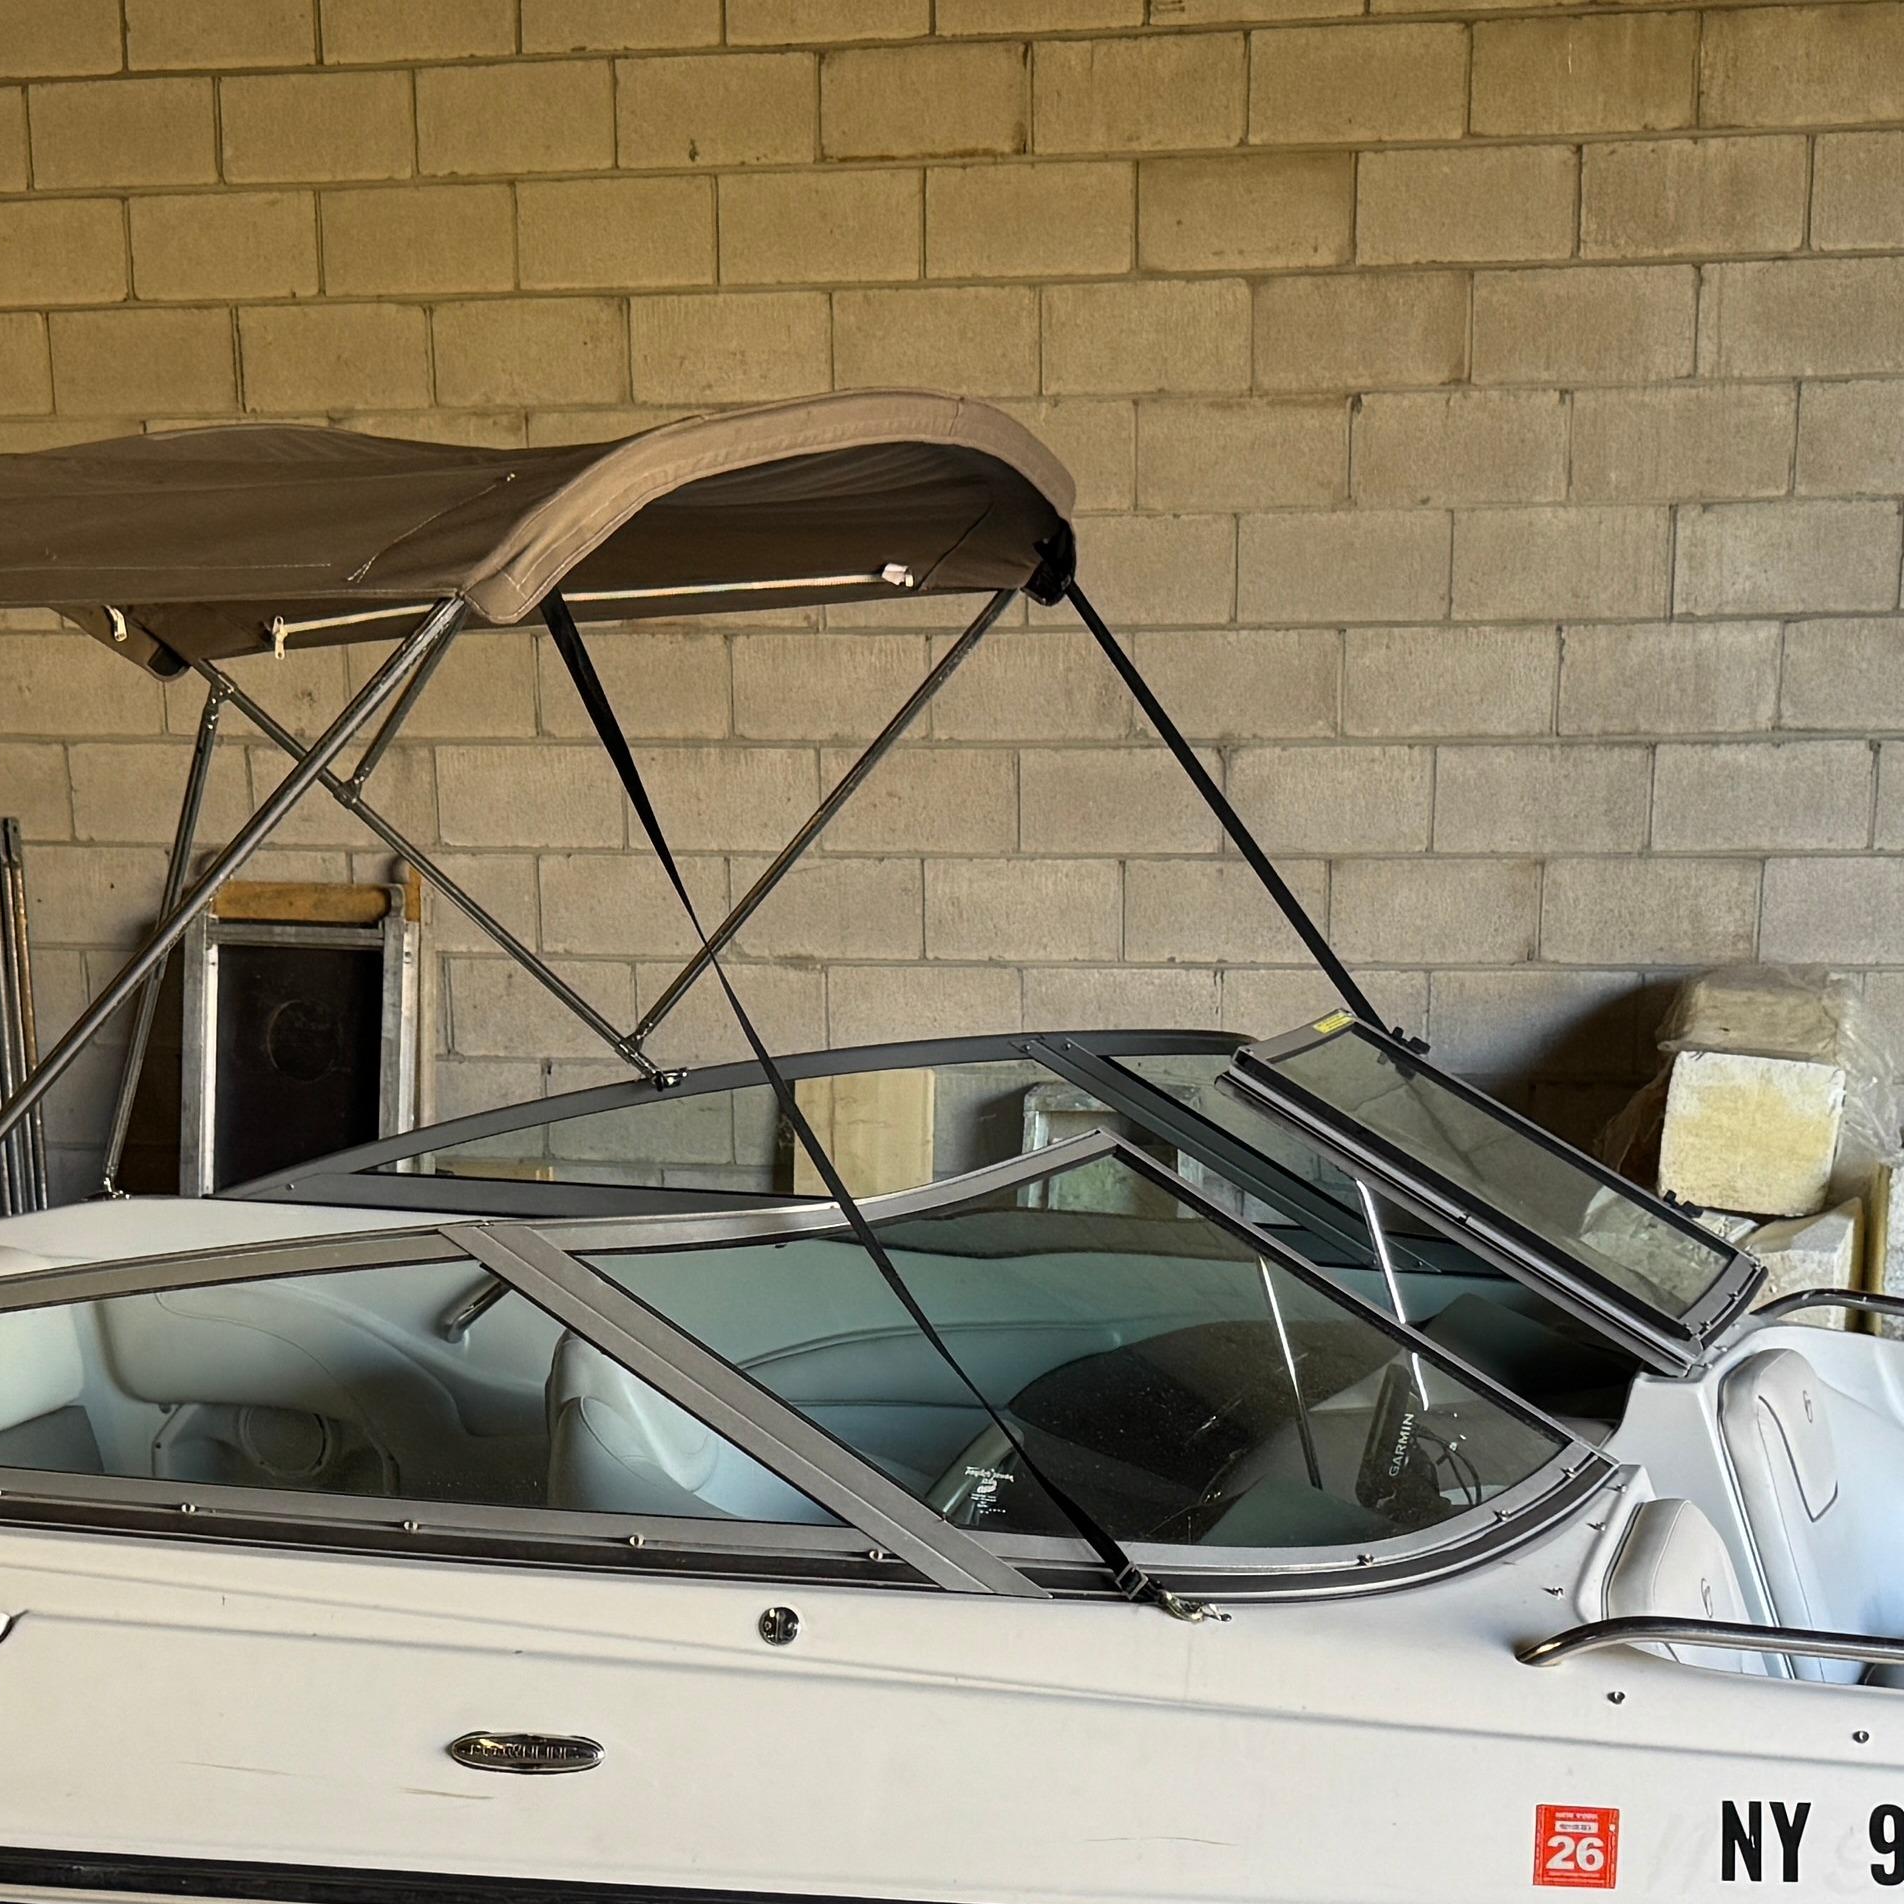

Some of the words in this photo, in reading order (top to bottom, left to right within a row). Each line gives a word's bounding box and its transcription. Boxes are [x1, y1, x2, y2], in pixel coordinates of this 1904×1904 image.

[1389, 1413, 1414, 1477] GARMIN
[1545, 1834, 1605, 1872] 26
[1721, 1800, 1812, 1883] NY
